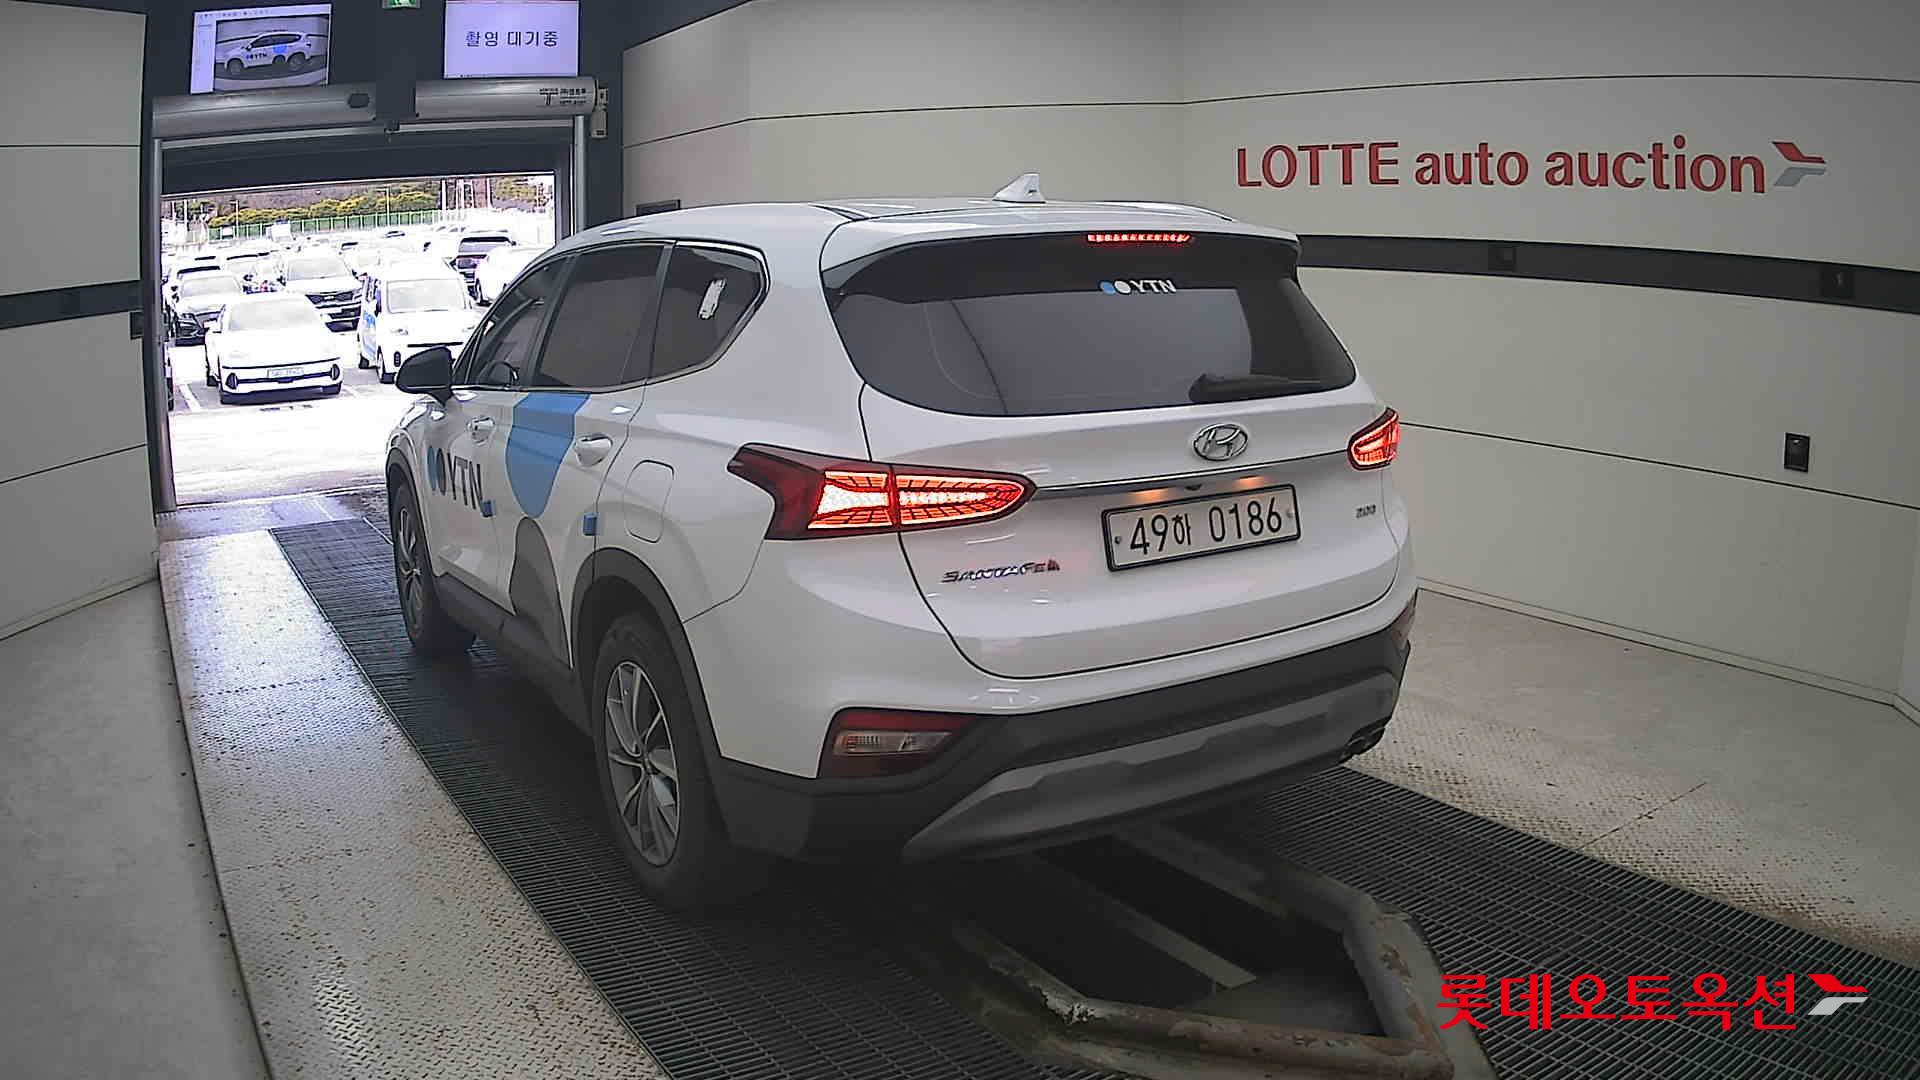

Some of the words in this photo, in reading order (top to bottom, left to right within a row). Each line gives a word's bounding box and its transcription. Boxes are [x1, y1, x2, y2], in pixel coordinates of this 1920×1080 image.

[466, 31, 499, 47] 촬영
[507, 31, 559, 47] 대기중
[1237, 142, 1399, 187] LOTTE
[1415, 142, 1529, 187] auto
[1544, 135, 1766, 193] auction
[1129, 279, 1177, 293] YTN
[447, 452, 483, 510] YTN
[1130, 513, 1192, 554] 49하
[1208, 497, 1282, 542] 0186
